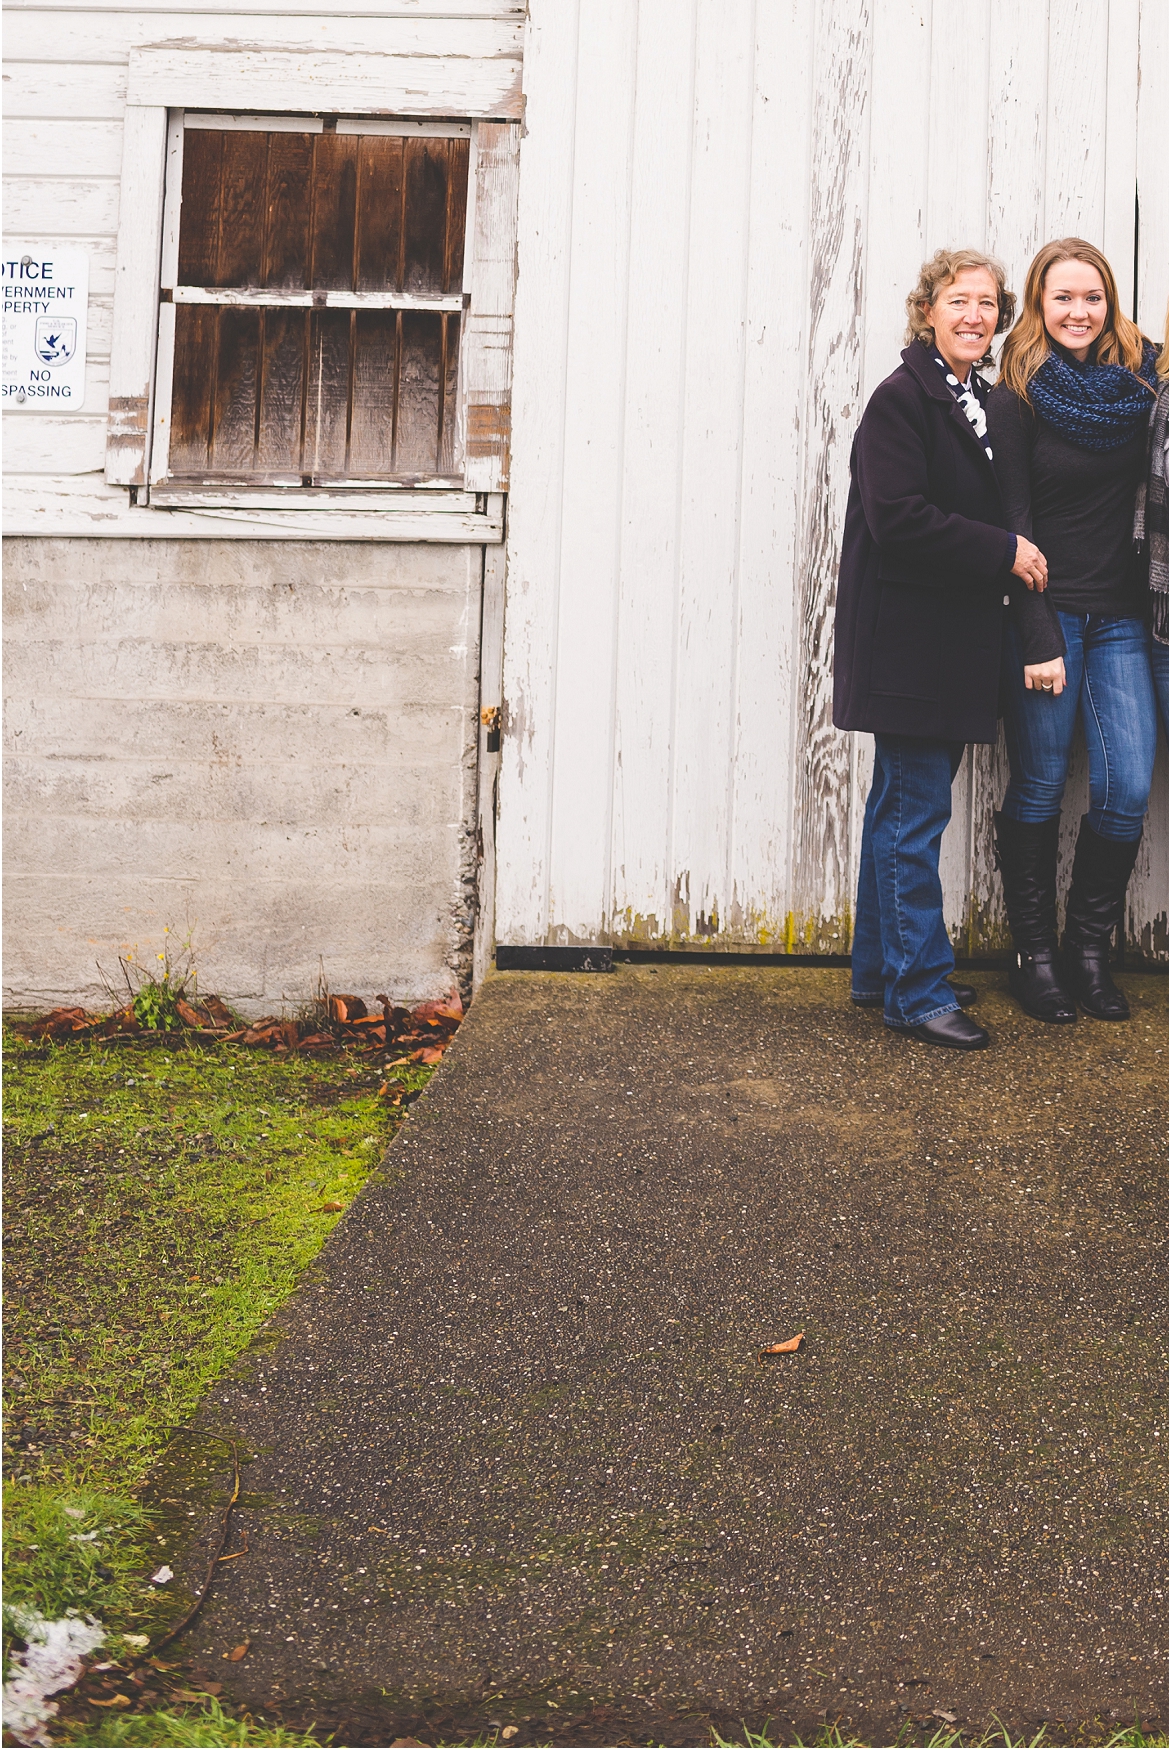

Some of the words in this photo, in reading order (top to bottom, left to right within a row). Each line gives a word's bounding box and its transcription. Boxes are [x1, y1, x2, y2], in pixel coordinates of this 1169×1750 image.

[2, 261, 53, 279] TICE
[2, 301, 50, 313] PERTY
[30, 370, 51, 381] NO
